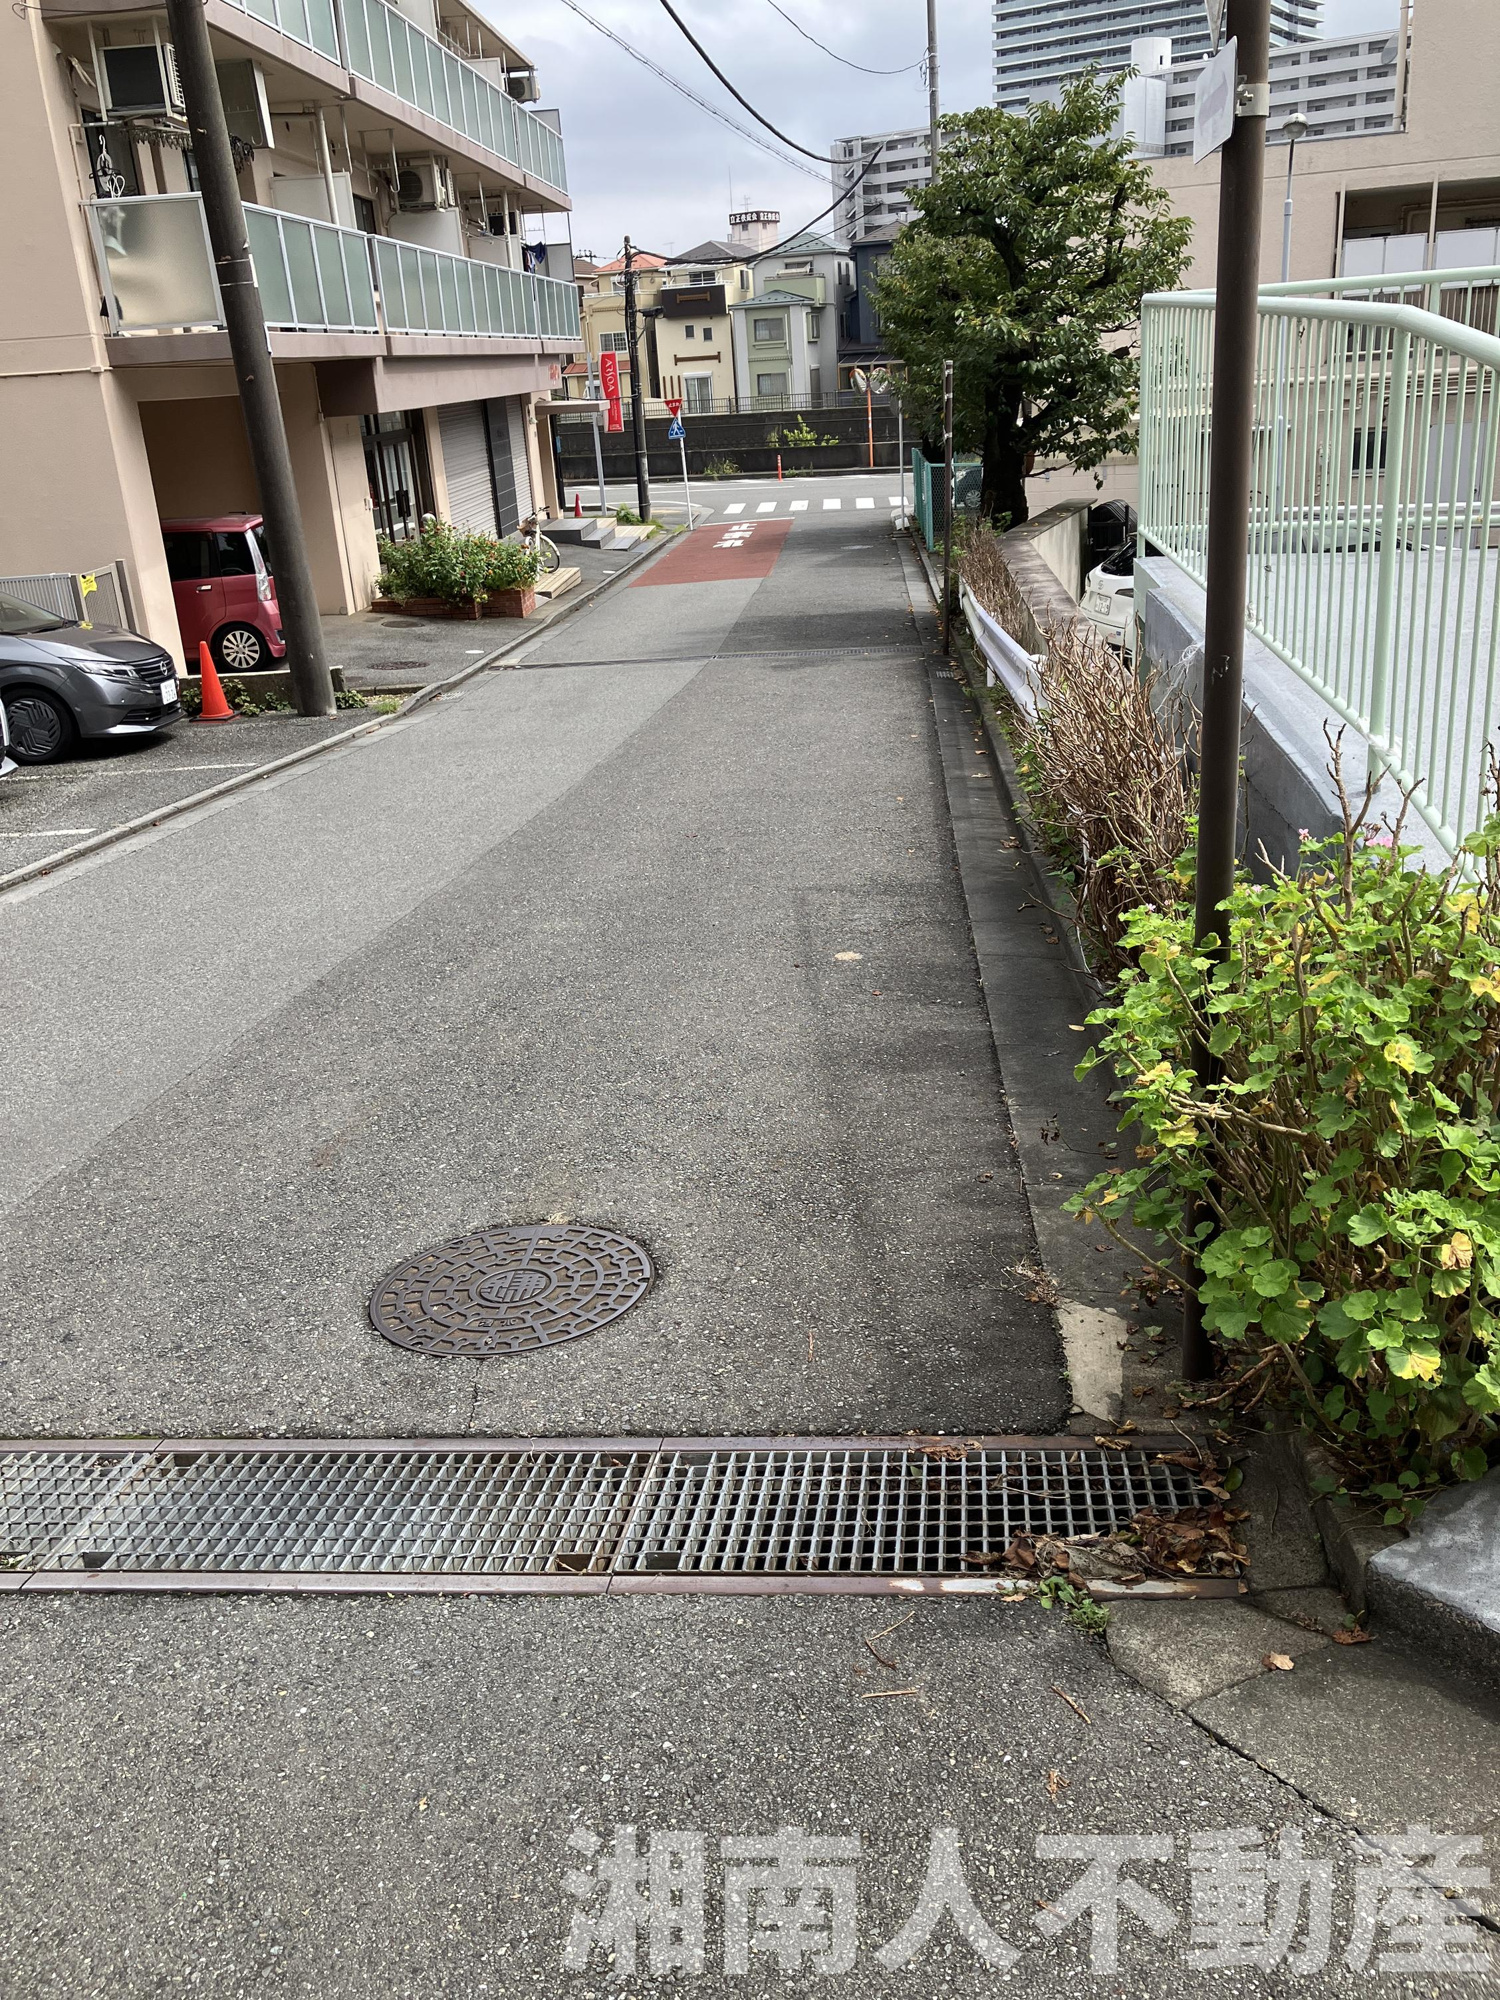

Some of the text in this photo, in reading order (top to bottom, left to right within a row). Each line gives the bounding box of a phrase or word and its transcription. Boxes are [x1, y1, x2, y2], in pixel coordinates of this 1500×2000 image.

[604, 358, 615, 393] ARSOA
[712, 523, 758, 549] 止まれ
